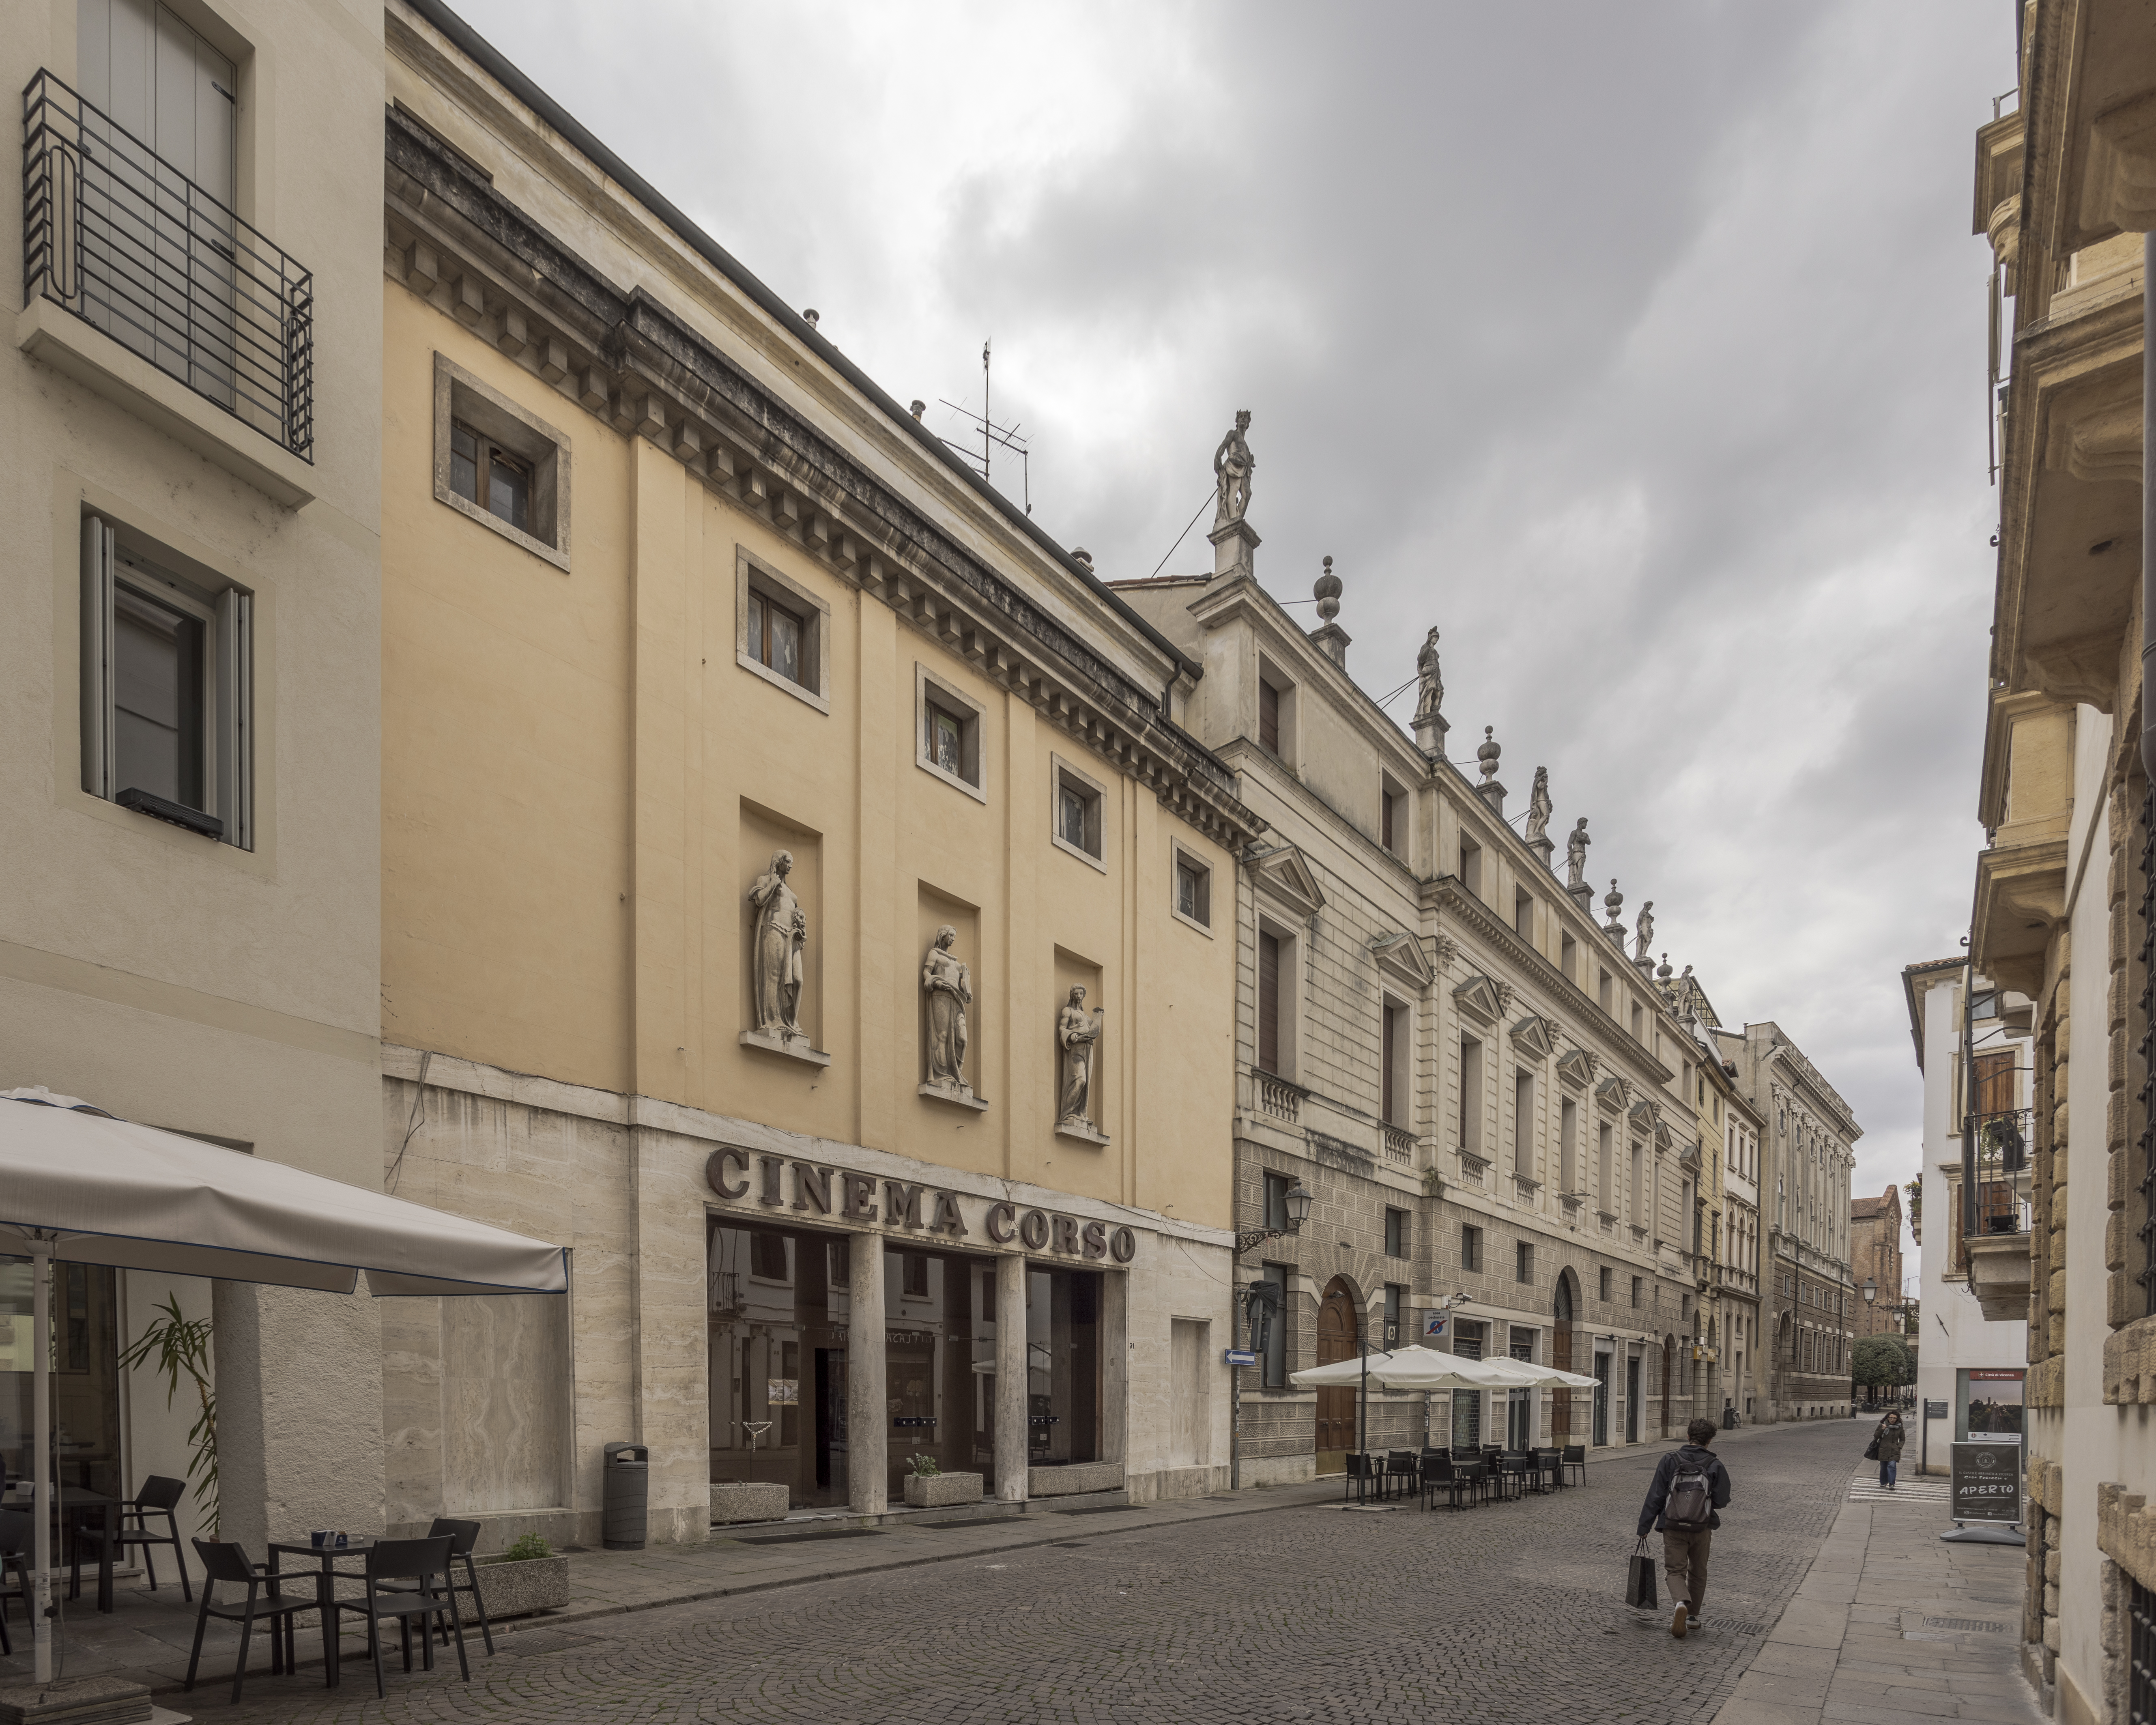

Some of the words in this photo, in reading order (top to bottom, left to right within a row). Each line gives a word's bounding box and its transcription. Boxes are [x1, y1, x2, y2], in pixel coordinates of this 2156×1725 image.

[706, 1146, 968, 1235] CINEMA
[986, 1202, 1135, 1263] CORSO
[1959, 1484, 2014, 1495] APERTO
